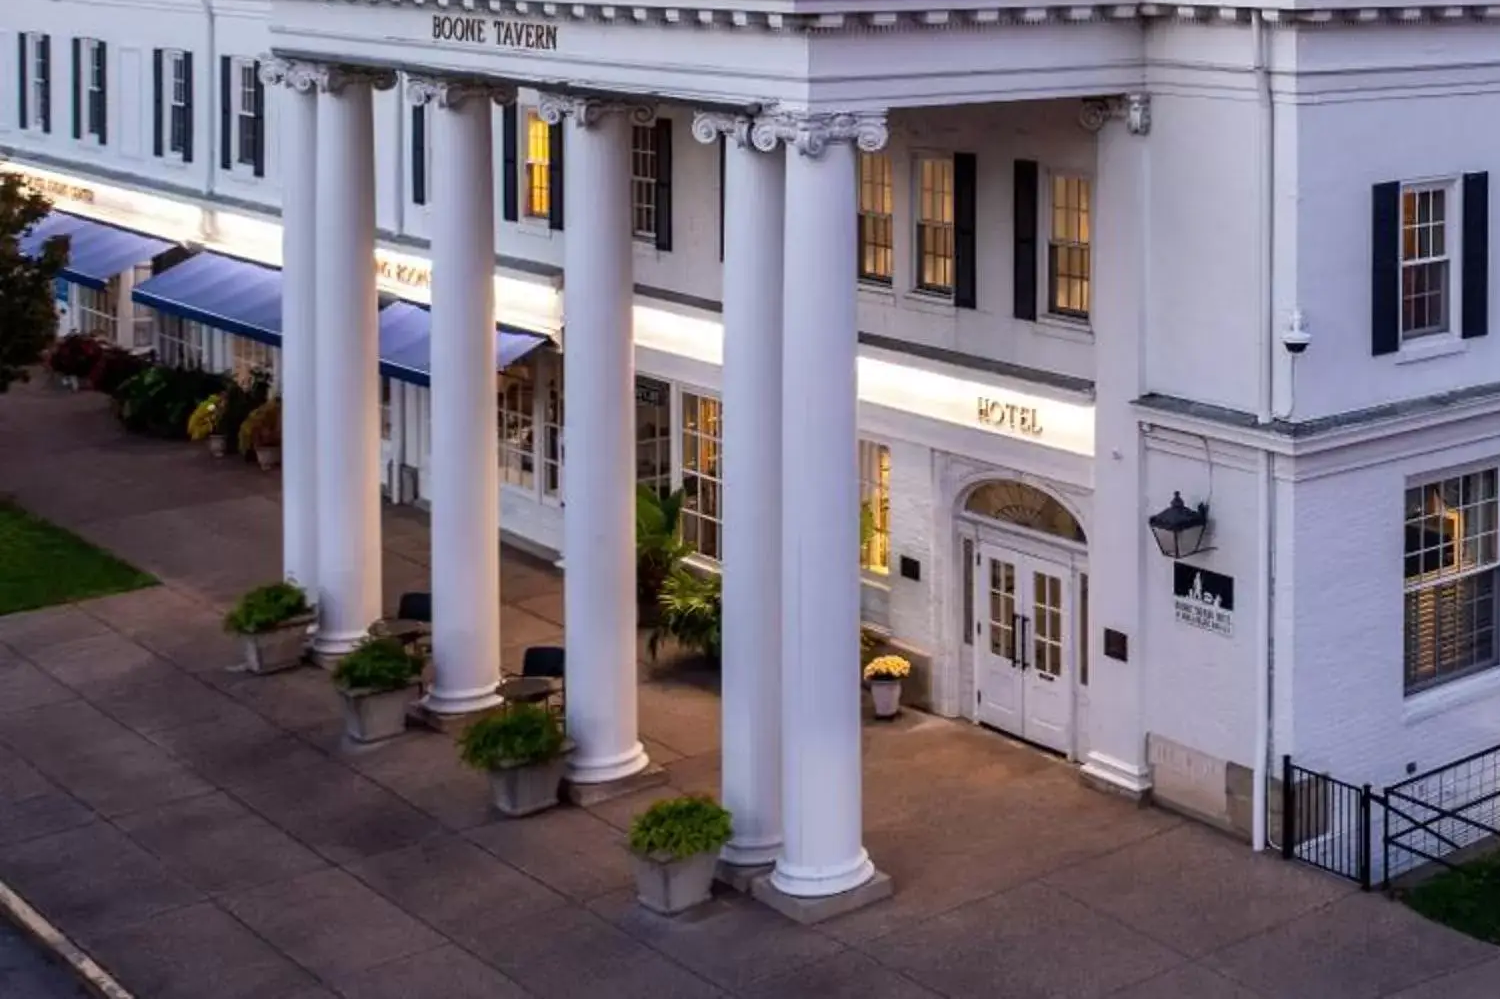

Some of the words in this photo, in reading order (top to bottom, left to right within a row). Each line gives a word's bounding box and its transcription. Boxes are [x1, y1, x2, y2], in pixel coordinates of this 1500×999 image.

[432, 14, 487, 43] BOONE
[493, 19, 559, 50] TAVERN
[977, 396, 1043, 437] HOTEL
